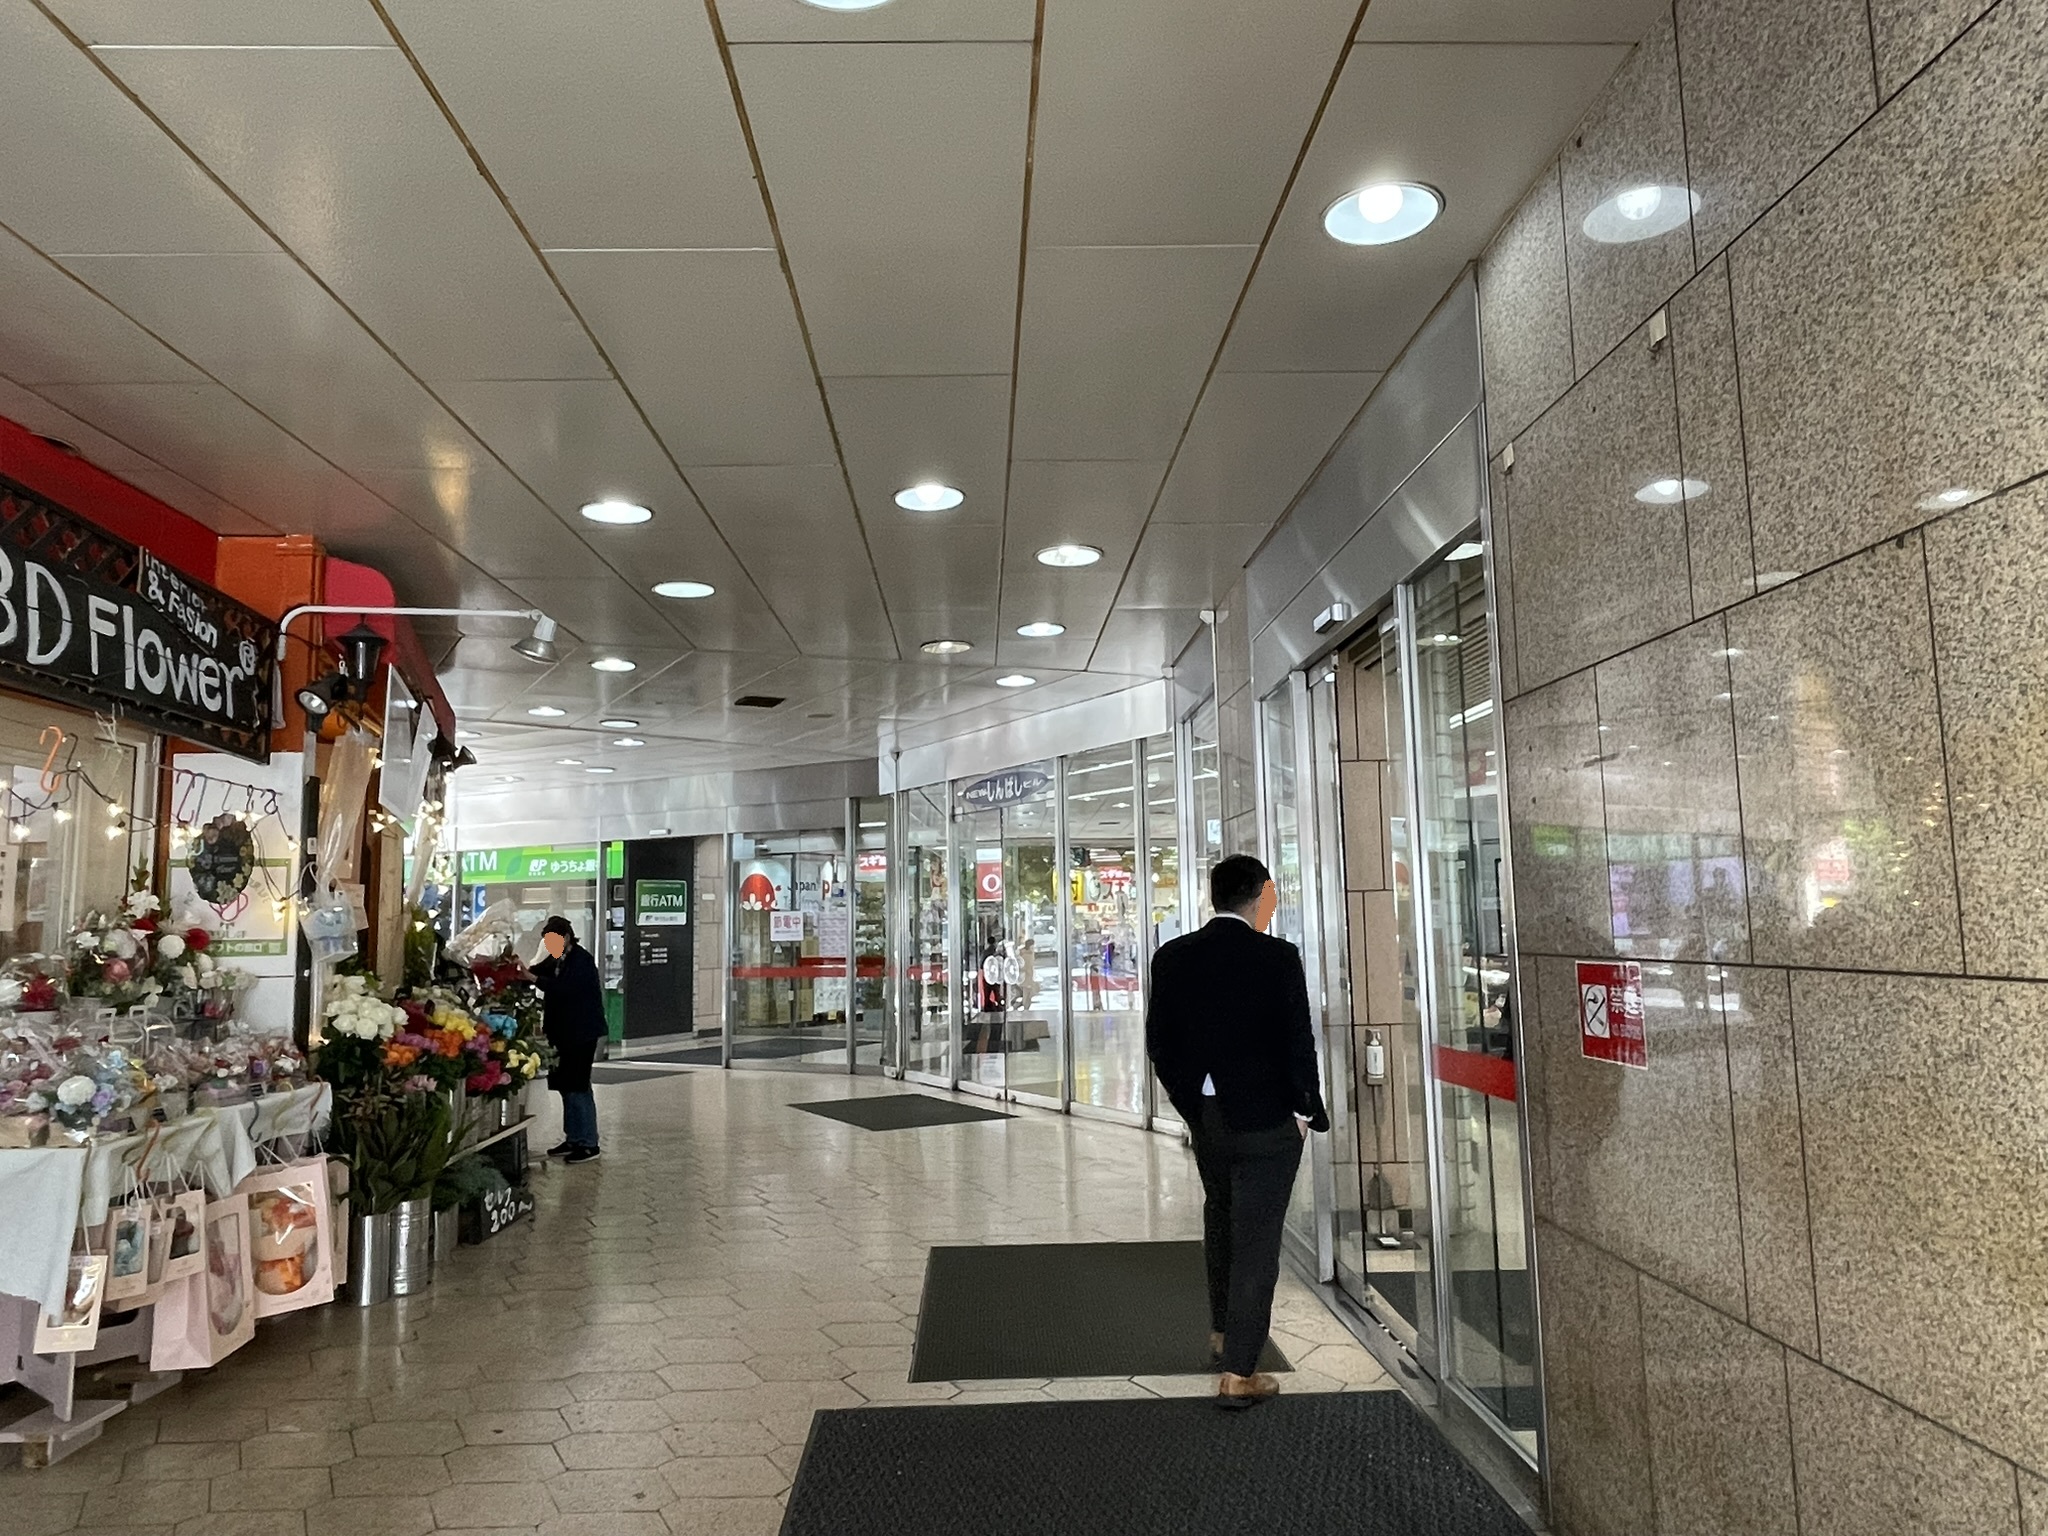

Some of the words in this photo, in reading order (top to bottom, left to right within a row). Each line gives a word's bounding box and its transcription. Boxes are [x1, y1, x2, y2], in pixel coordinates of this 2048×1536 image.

[148, 570, 166, 605] &
[550, 857, 599, 875] ゆうちょ銀
